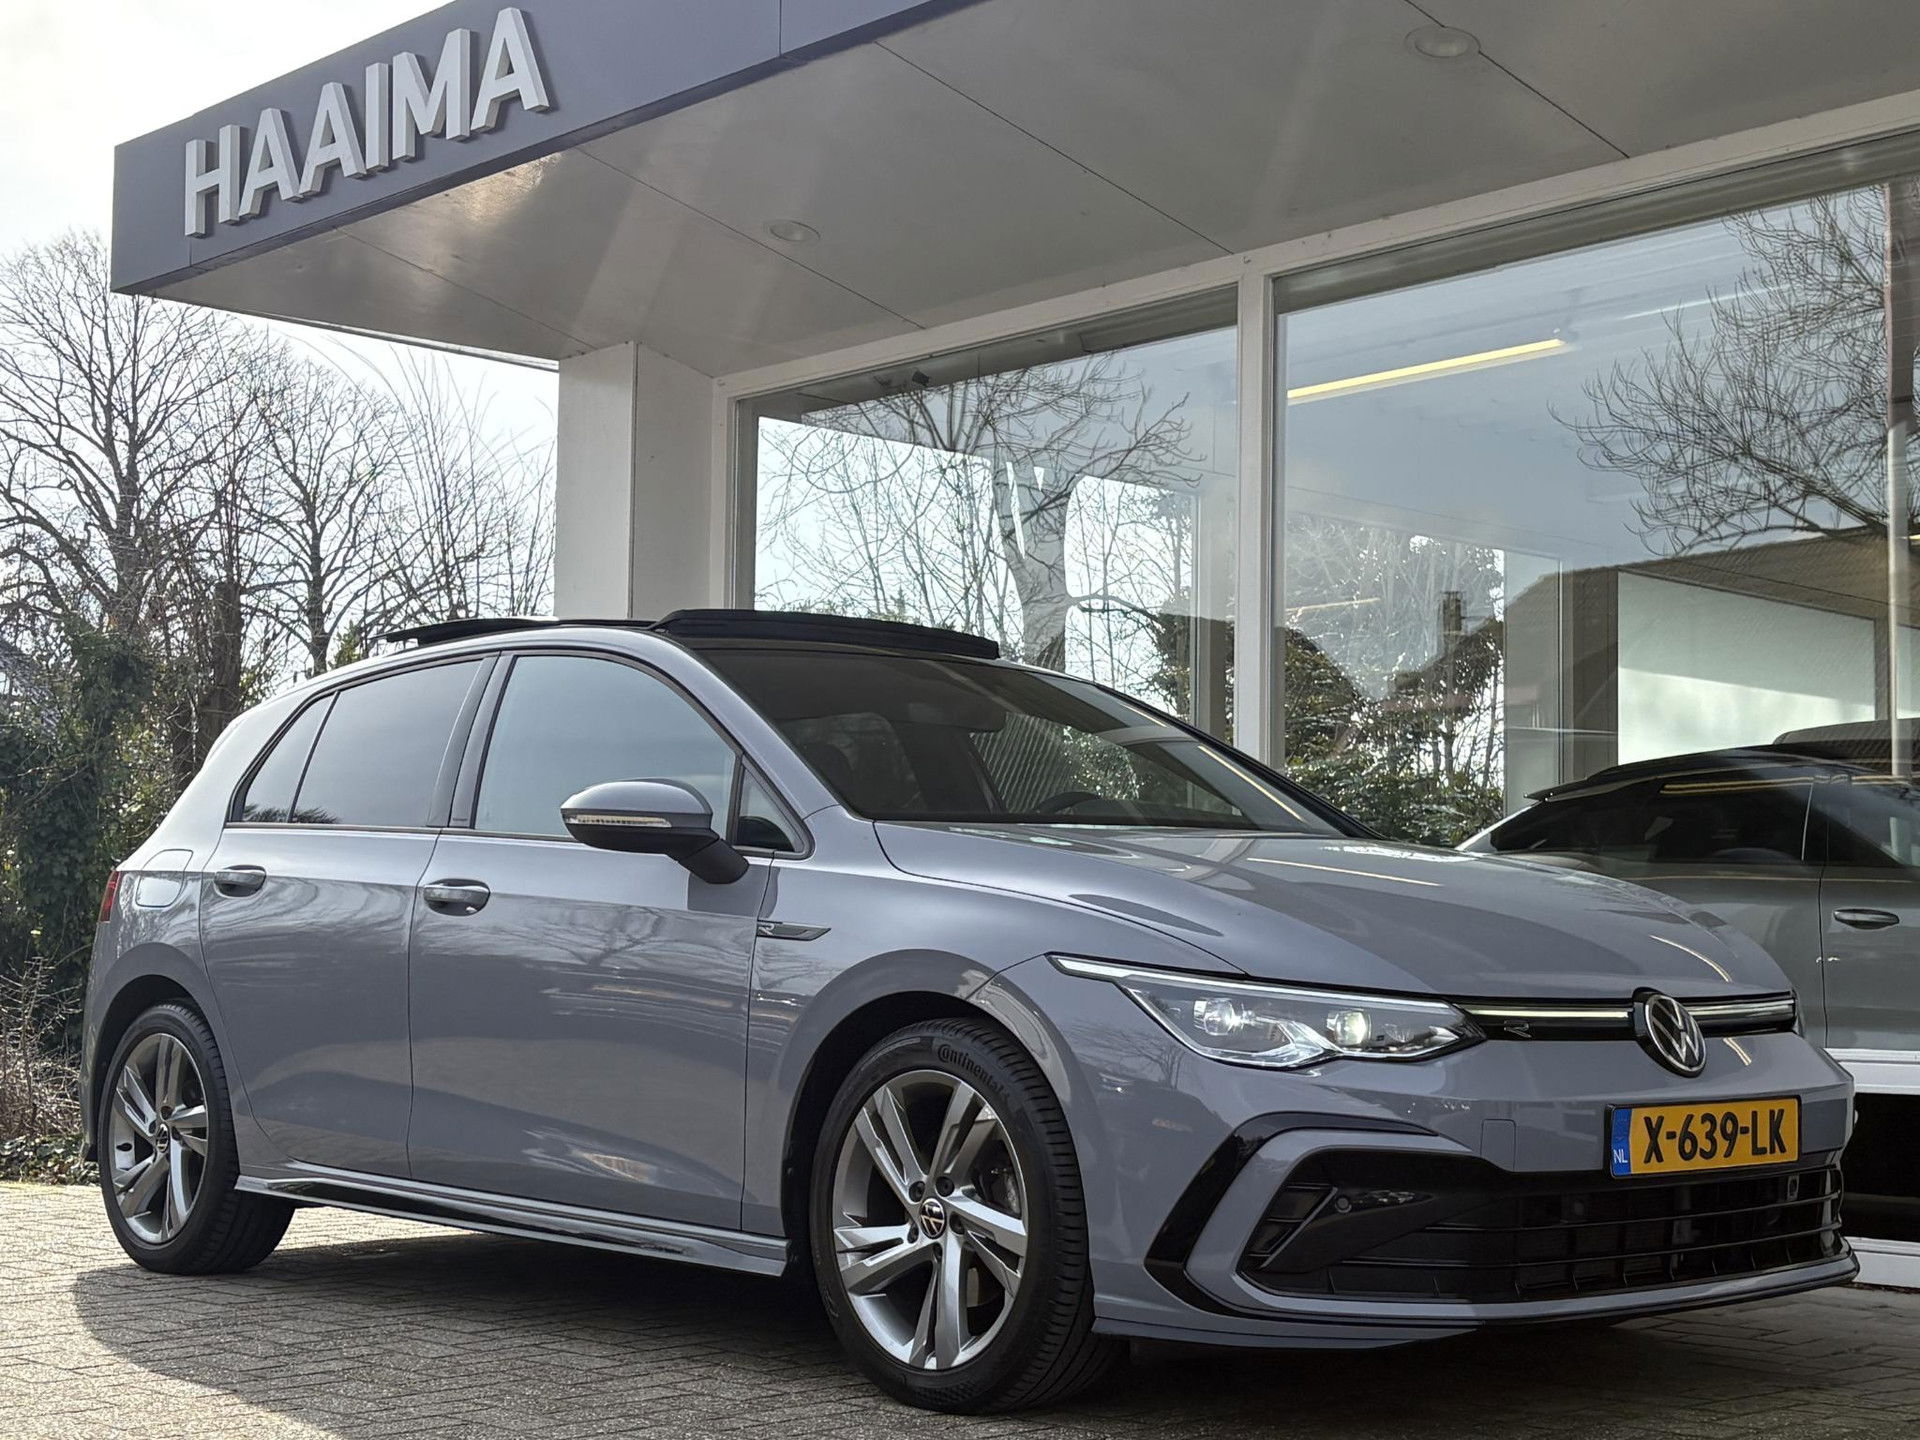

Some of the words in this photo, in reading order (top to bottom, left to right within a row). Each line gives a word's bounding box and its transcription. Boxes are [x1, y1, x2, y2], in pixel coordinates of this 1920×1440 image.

[185, 7, 551, 238] HAAIMA
[938, 1043, 1004, 1093] Continental
[1613, 1149, 1628, 1163] NL
[1643, 1108, 1787, 1164] X-639-LK
